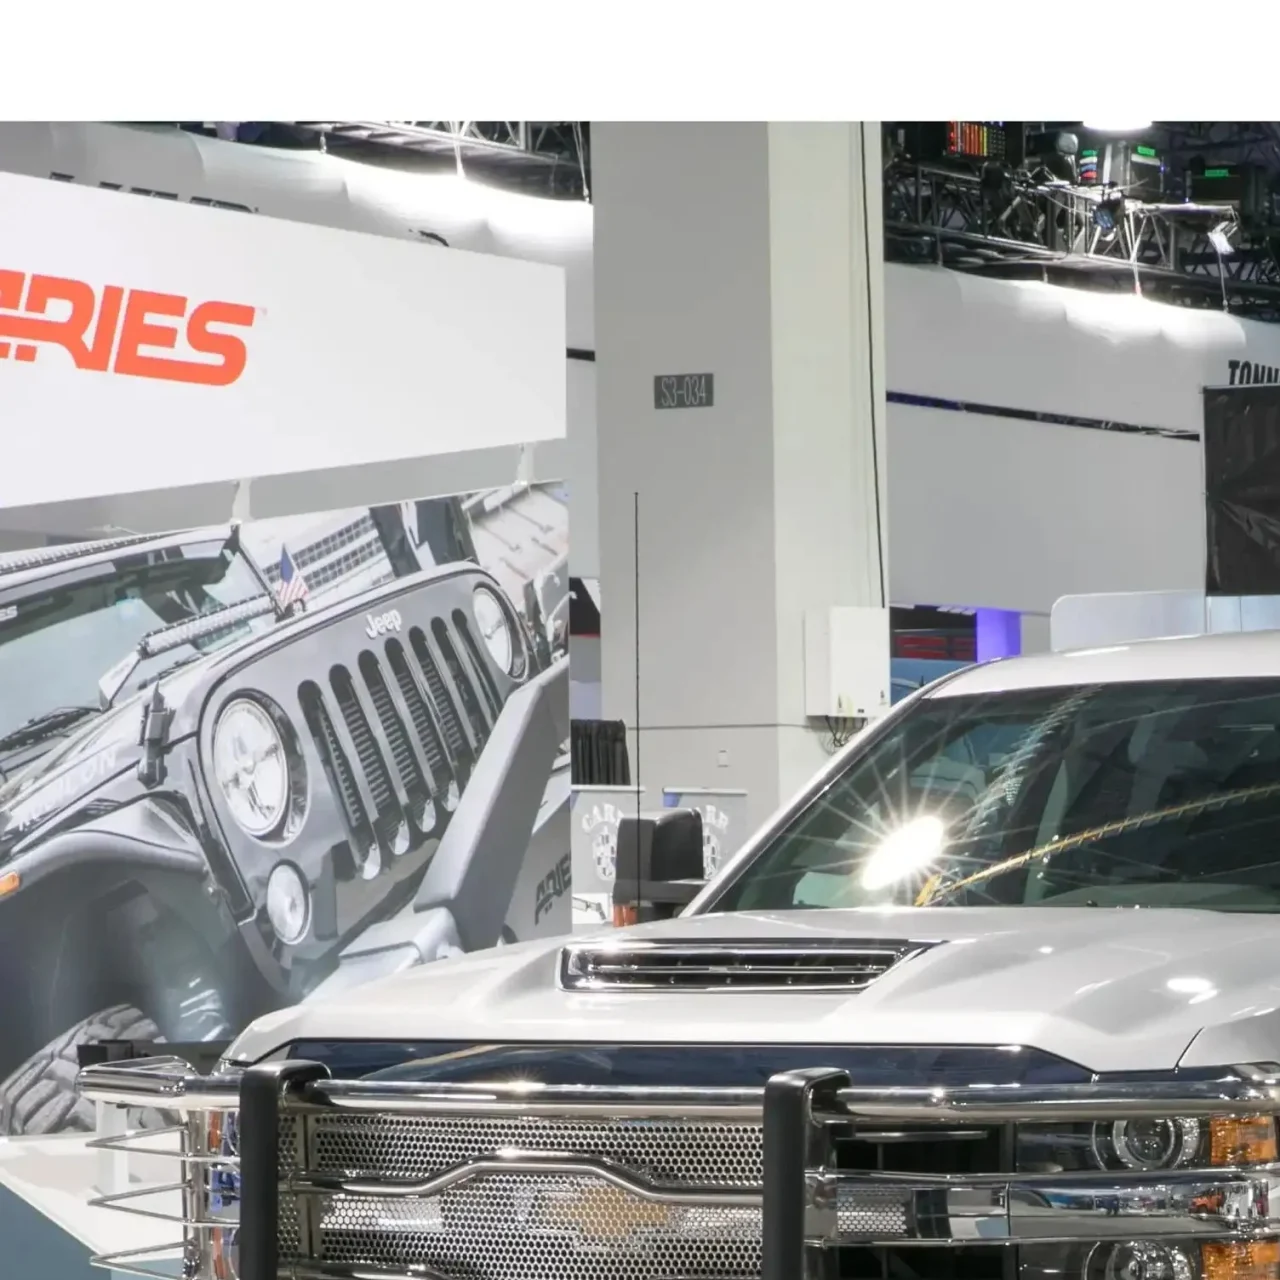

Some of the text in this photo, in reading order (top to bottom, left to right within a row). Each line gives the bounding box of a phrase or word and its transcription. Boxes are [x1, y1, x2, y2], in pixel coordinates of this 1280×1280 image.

[661, 375, 706, 407] S3-034
[365, 609, 402, 639] Jeep
[535, 850, 572, 926] ARIE
